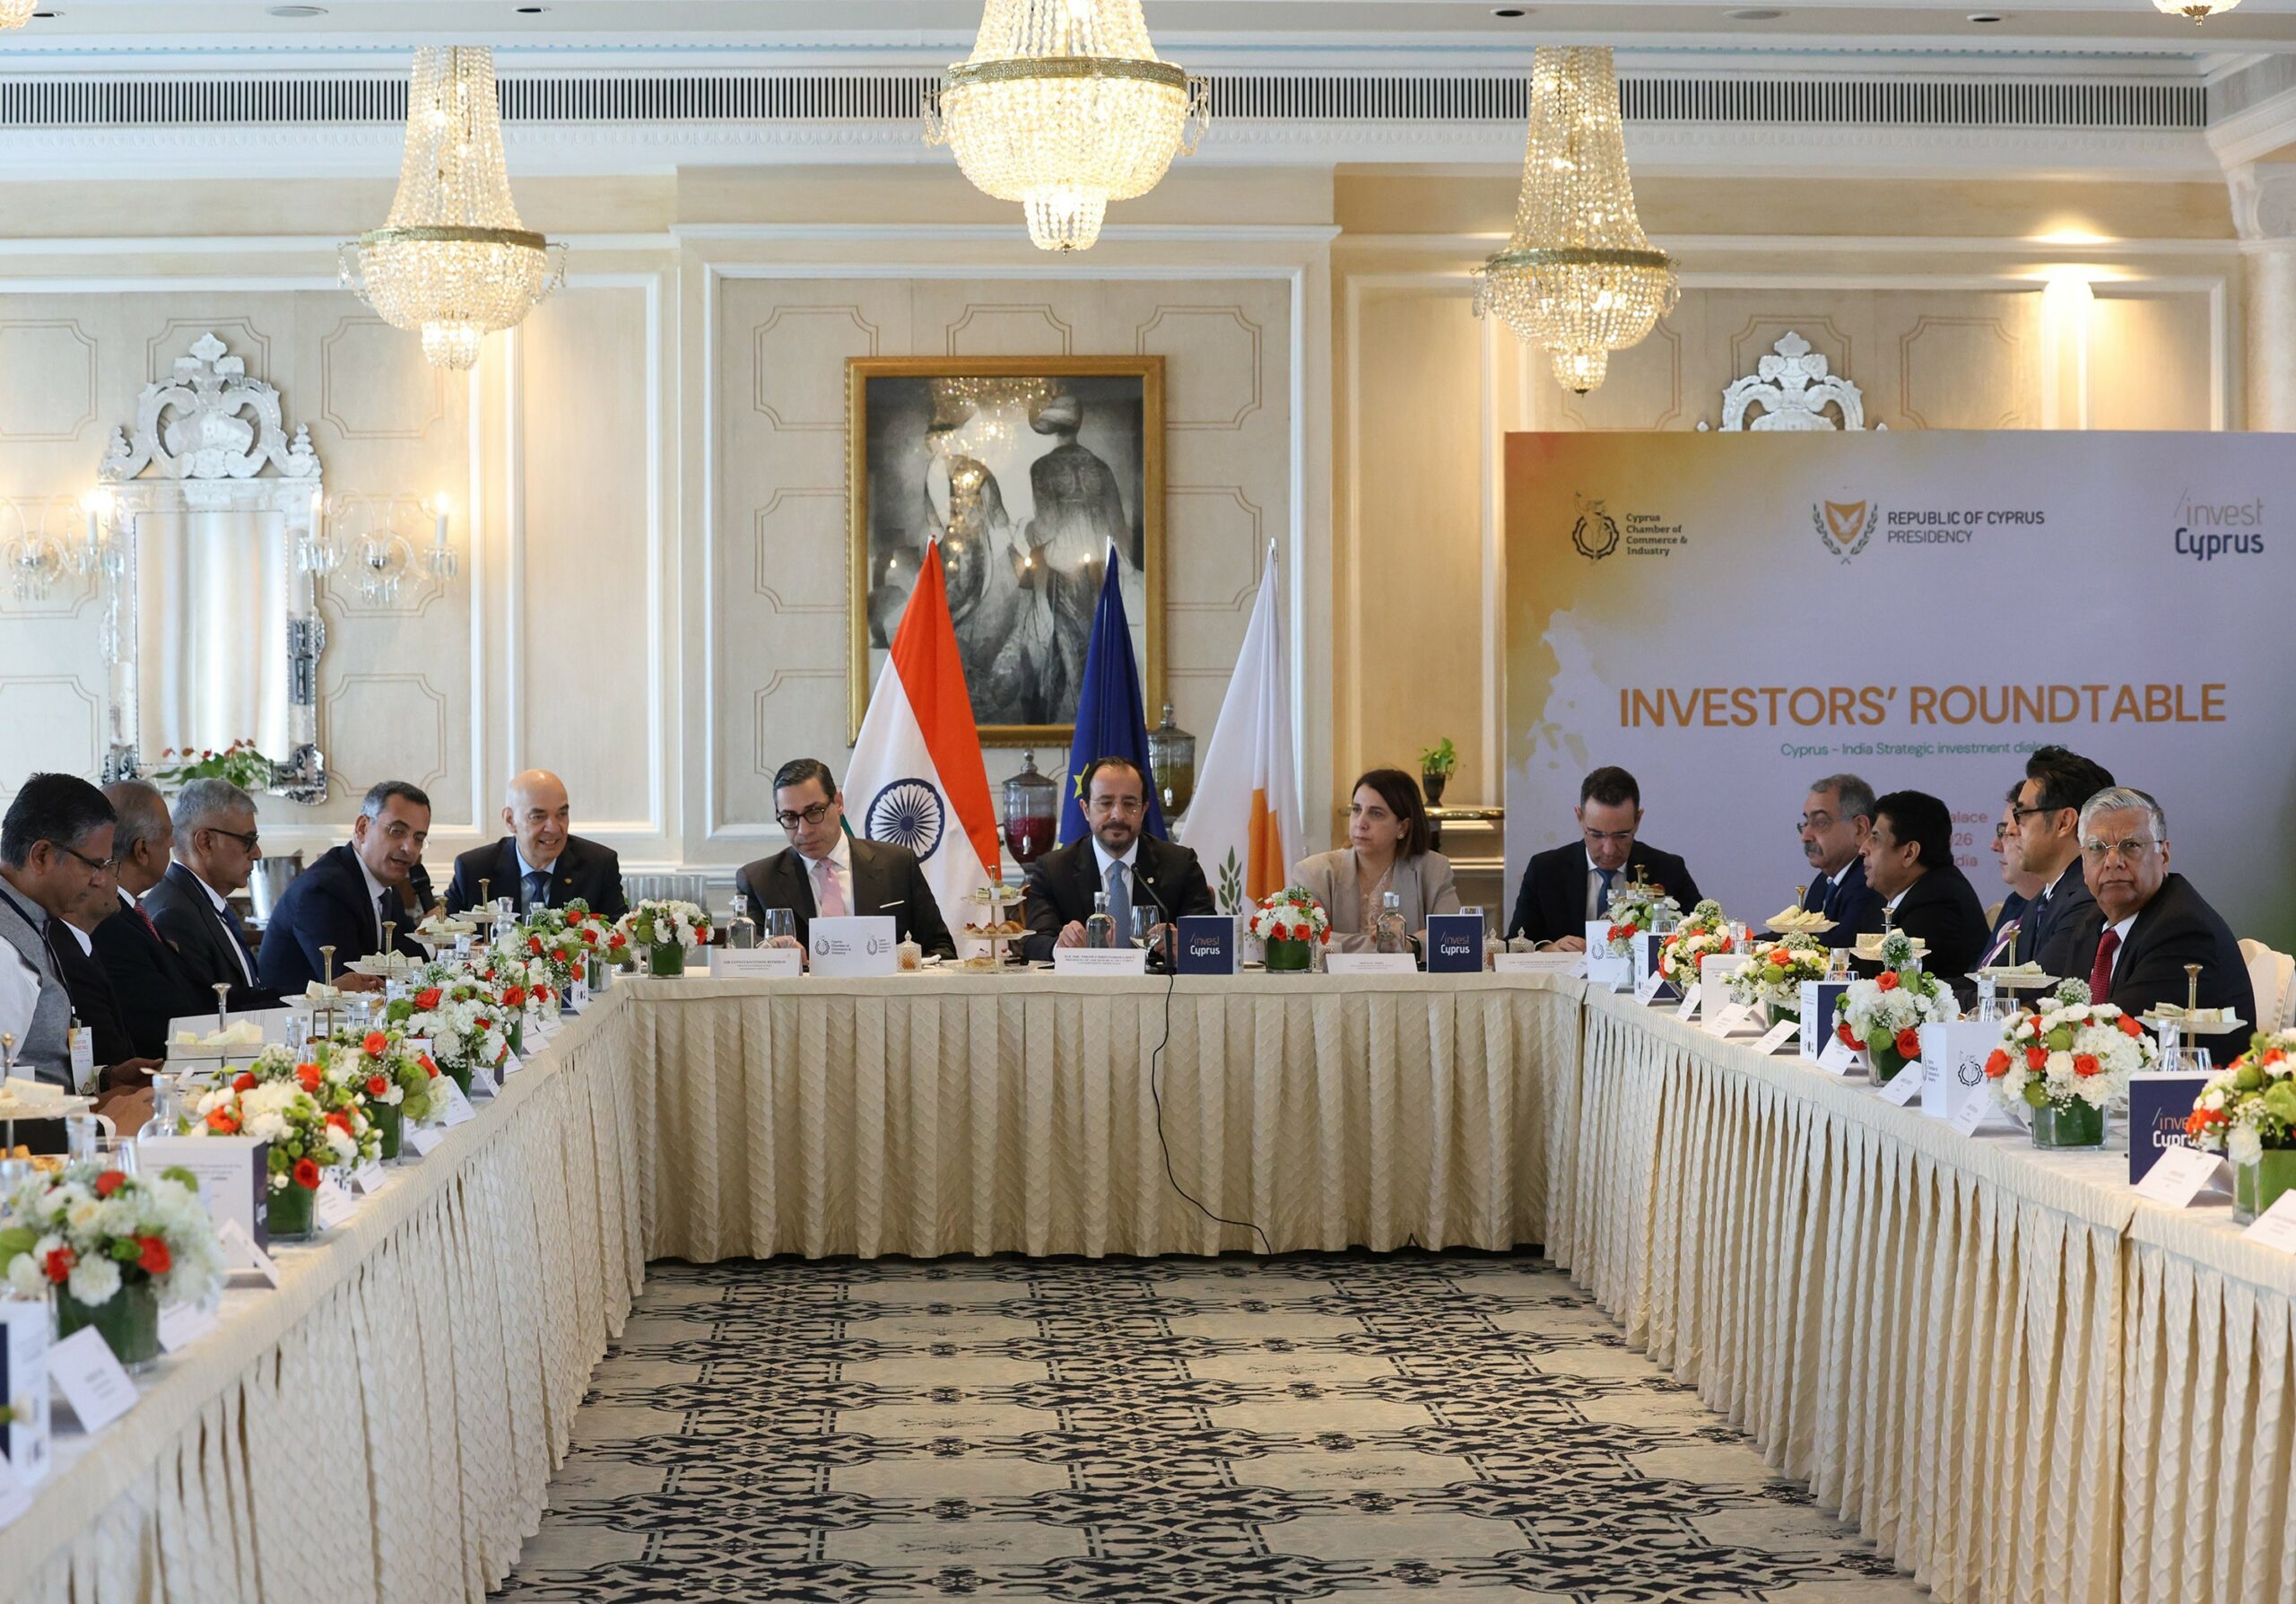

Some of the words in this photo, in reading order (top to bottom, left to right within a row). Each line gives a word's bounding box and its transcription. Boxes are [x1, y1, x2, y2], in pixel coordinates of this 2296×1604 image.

[1626, 513, 1661, 523] Cyprus
[1887, 510, 1960, 526] REPUBLIC
[1964, 511, 1983, 525] OF
[1987, 510, 2045, 525] CYPRUS
[1626, 525, 1669, 534] Chamber
[1672, 525, 1682, 533] of
[1626, 536, 1677, 545] Commerce
[1680, 536, 1688, 545] &
[1887, 530, 1973, 544] PRESIDENCY
[2175, 527, 2264, 561] Cyprus
[1627, 546, 1670, 556] Industry
[1909, 684, 2227, 725] ROUNDTABLE
[1780, 743, 1829, 758] Cyprus
[1842, 743, 1874, 755] India
[1876, 742, 1935, 758] Strategic
[1937, 742, 2010, 754] investment
[1190, 945, 1221, 957] Cyprus
[1440, 944, 1470, 956] Cyprus
